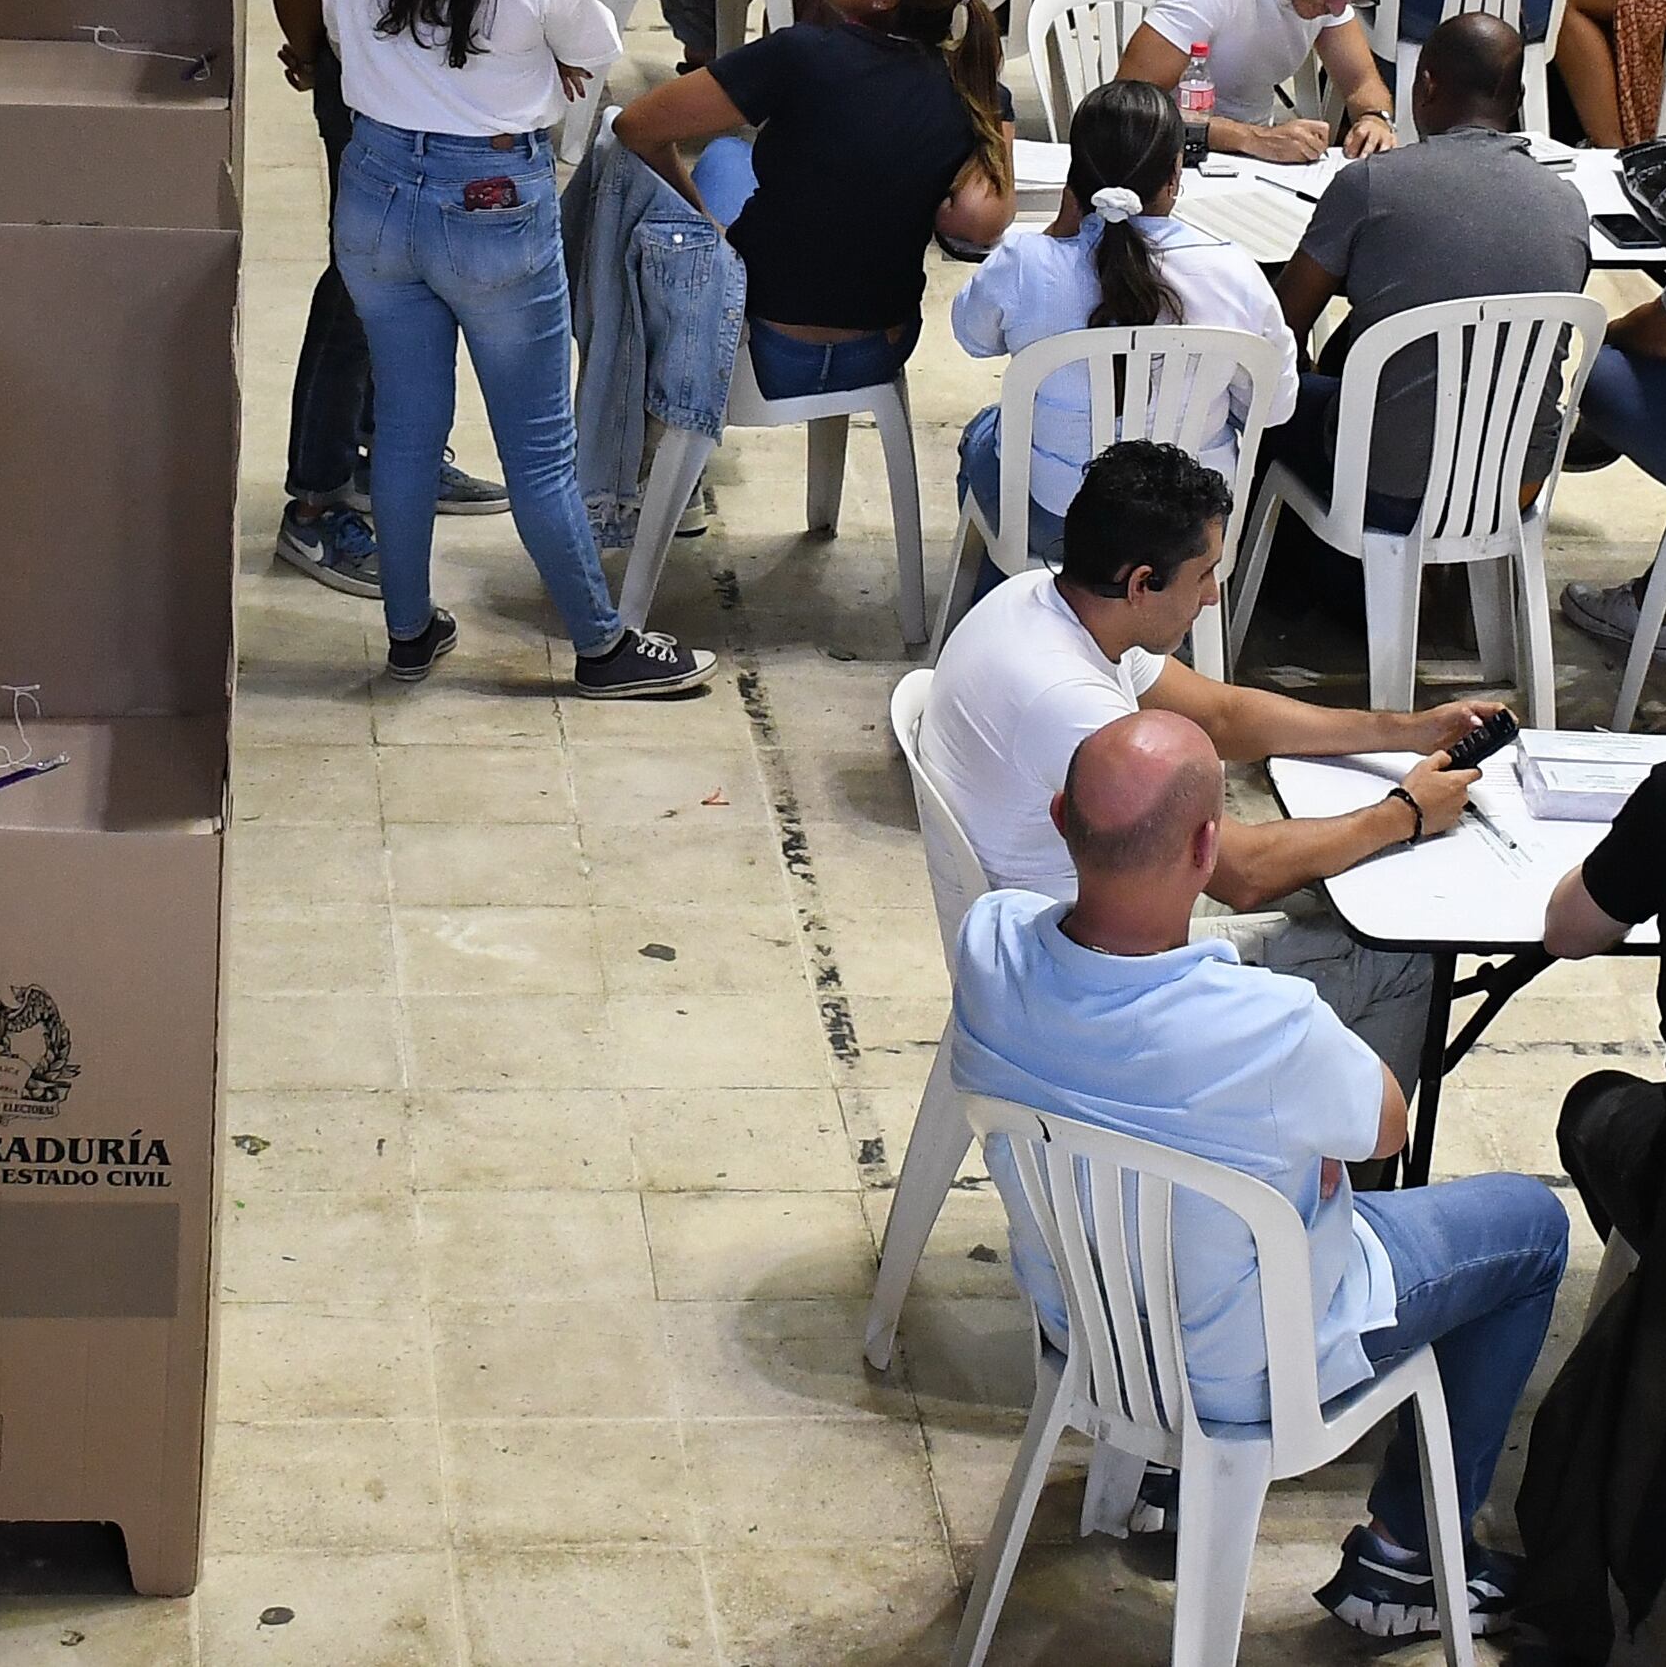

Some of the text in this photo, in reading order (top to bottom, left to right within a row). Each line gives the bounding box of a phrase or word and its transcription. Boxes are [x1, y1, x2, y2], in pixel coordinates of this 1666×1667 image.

[2, 1102, 56, 1115] ELECTORAL
[1, 1168, 99, 1185] ESTADO
[106, 1168, 172, 1187] CIVIL
